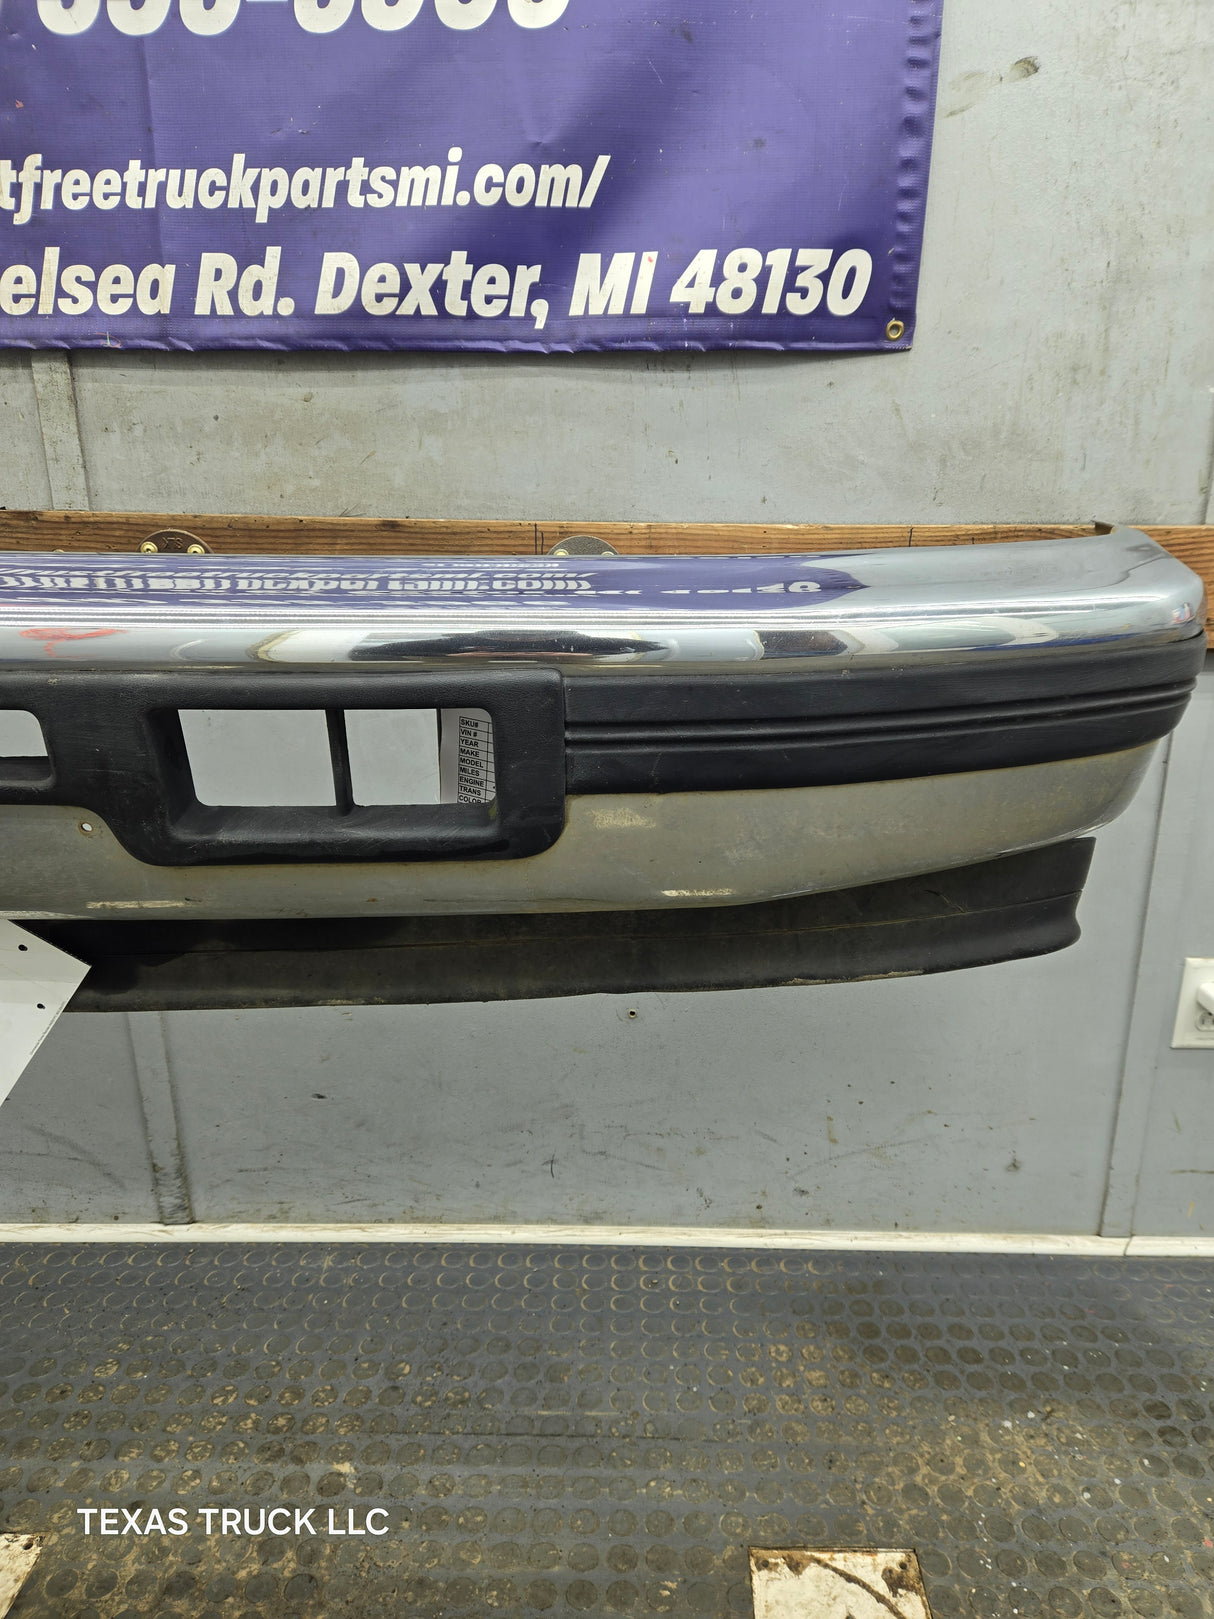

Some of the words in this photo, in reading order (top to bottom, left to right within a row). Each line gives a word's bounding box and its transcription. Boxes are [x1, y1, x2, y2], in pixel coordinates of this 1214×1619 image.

[0, 147, 612, 225] tfreetruckpartsmi.com/
[0, 246, 177, 317] elsea
[193, 246, 295, 317] Rd.
[315, 250, 549, 330] Dexter,
[568, 250, 659, 317] MI
[669, 247, 873, 316] 48130
[460, 728, 472, 737] VIN
[460, 738, 479, 748] YEAR
[460, 747, 480, 758] MAKE
[460, 757, 484, 768] MODEL
[460, 766, 480, 777] MILES
[459, 776, 485, 788] ENGINE
[460, 785, 482, 796] TRANS
